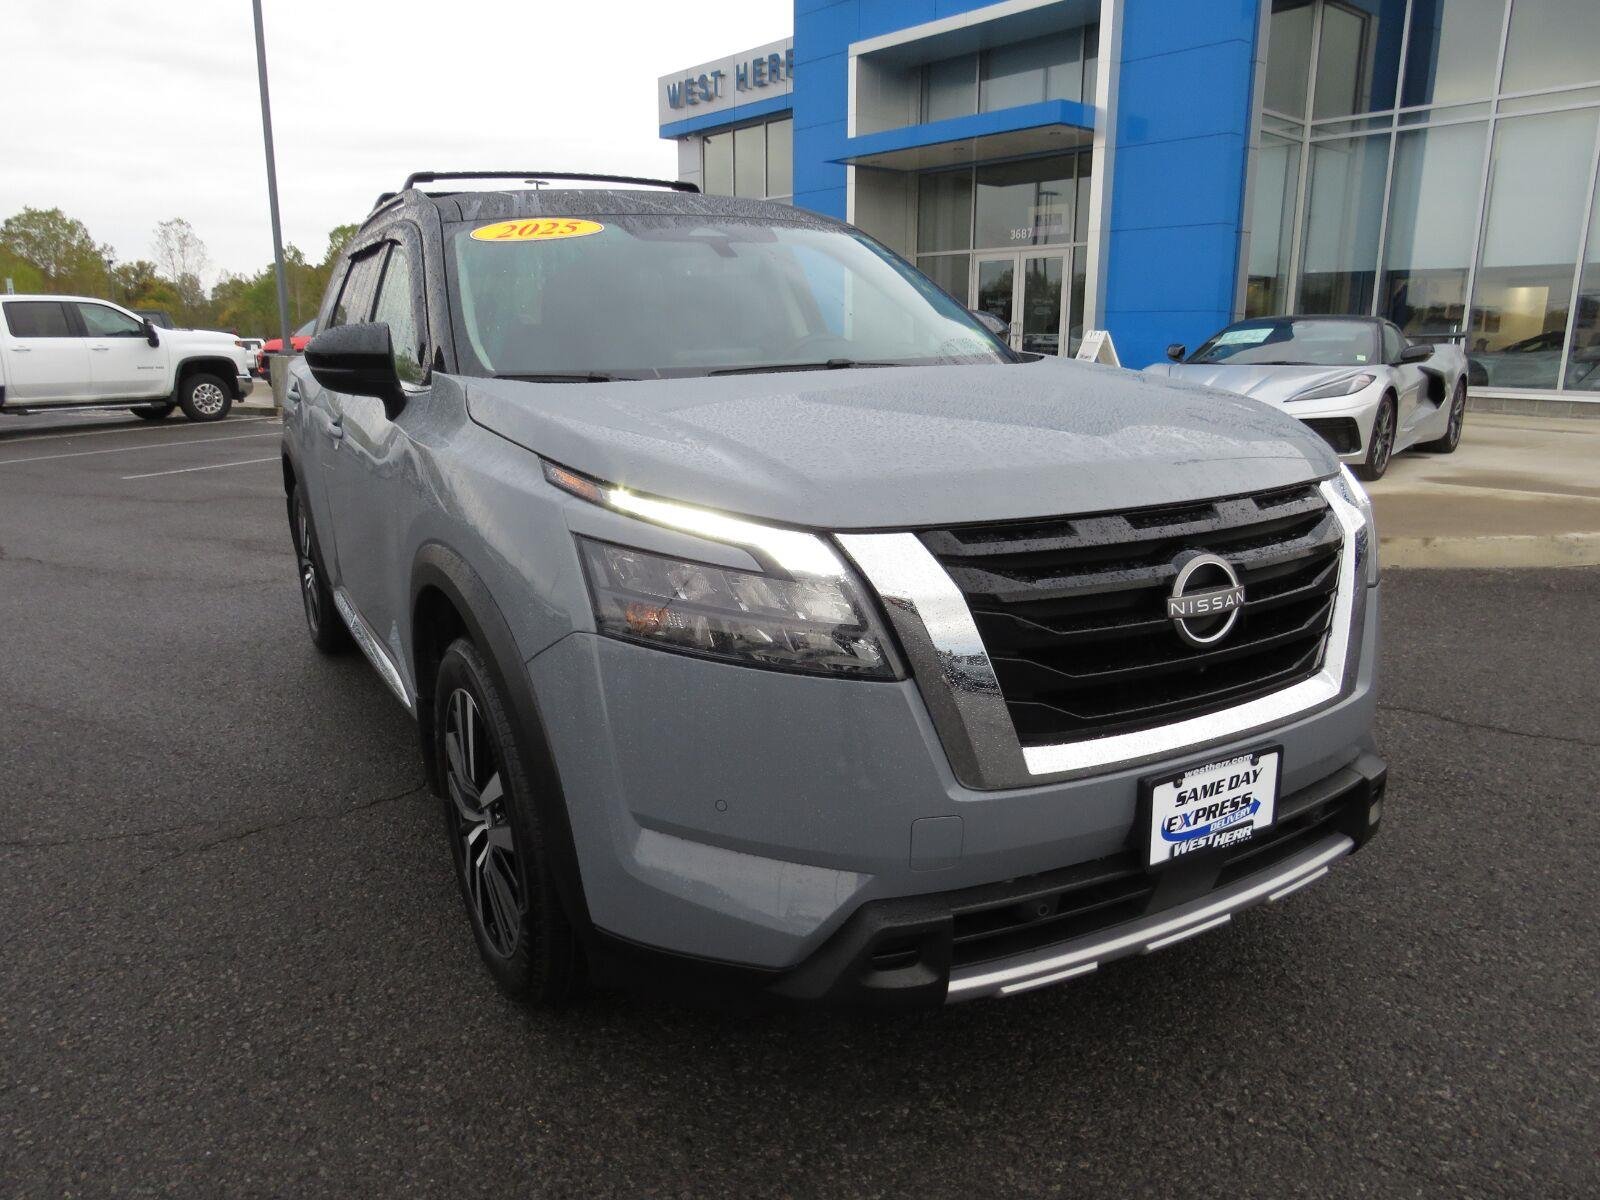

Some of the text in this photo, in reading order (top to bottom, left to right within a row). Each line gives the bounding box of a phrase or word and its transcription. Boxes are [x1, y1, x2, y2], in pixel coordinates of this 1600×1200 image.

[667, 70, 722, 109] WEST
[496, 222, 581, 239] 2025
[1171, 590, 1244, 615] NISSAN
[1184, 753, 1253, 778] westherr.com
[1175, 767, 1263, 808] SAME DAY
[1166, 792, 1252, 833] EXPRESS
[1210, 807, 1251, 832] DELIVERY
